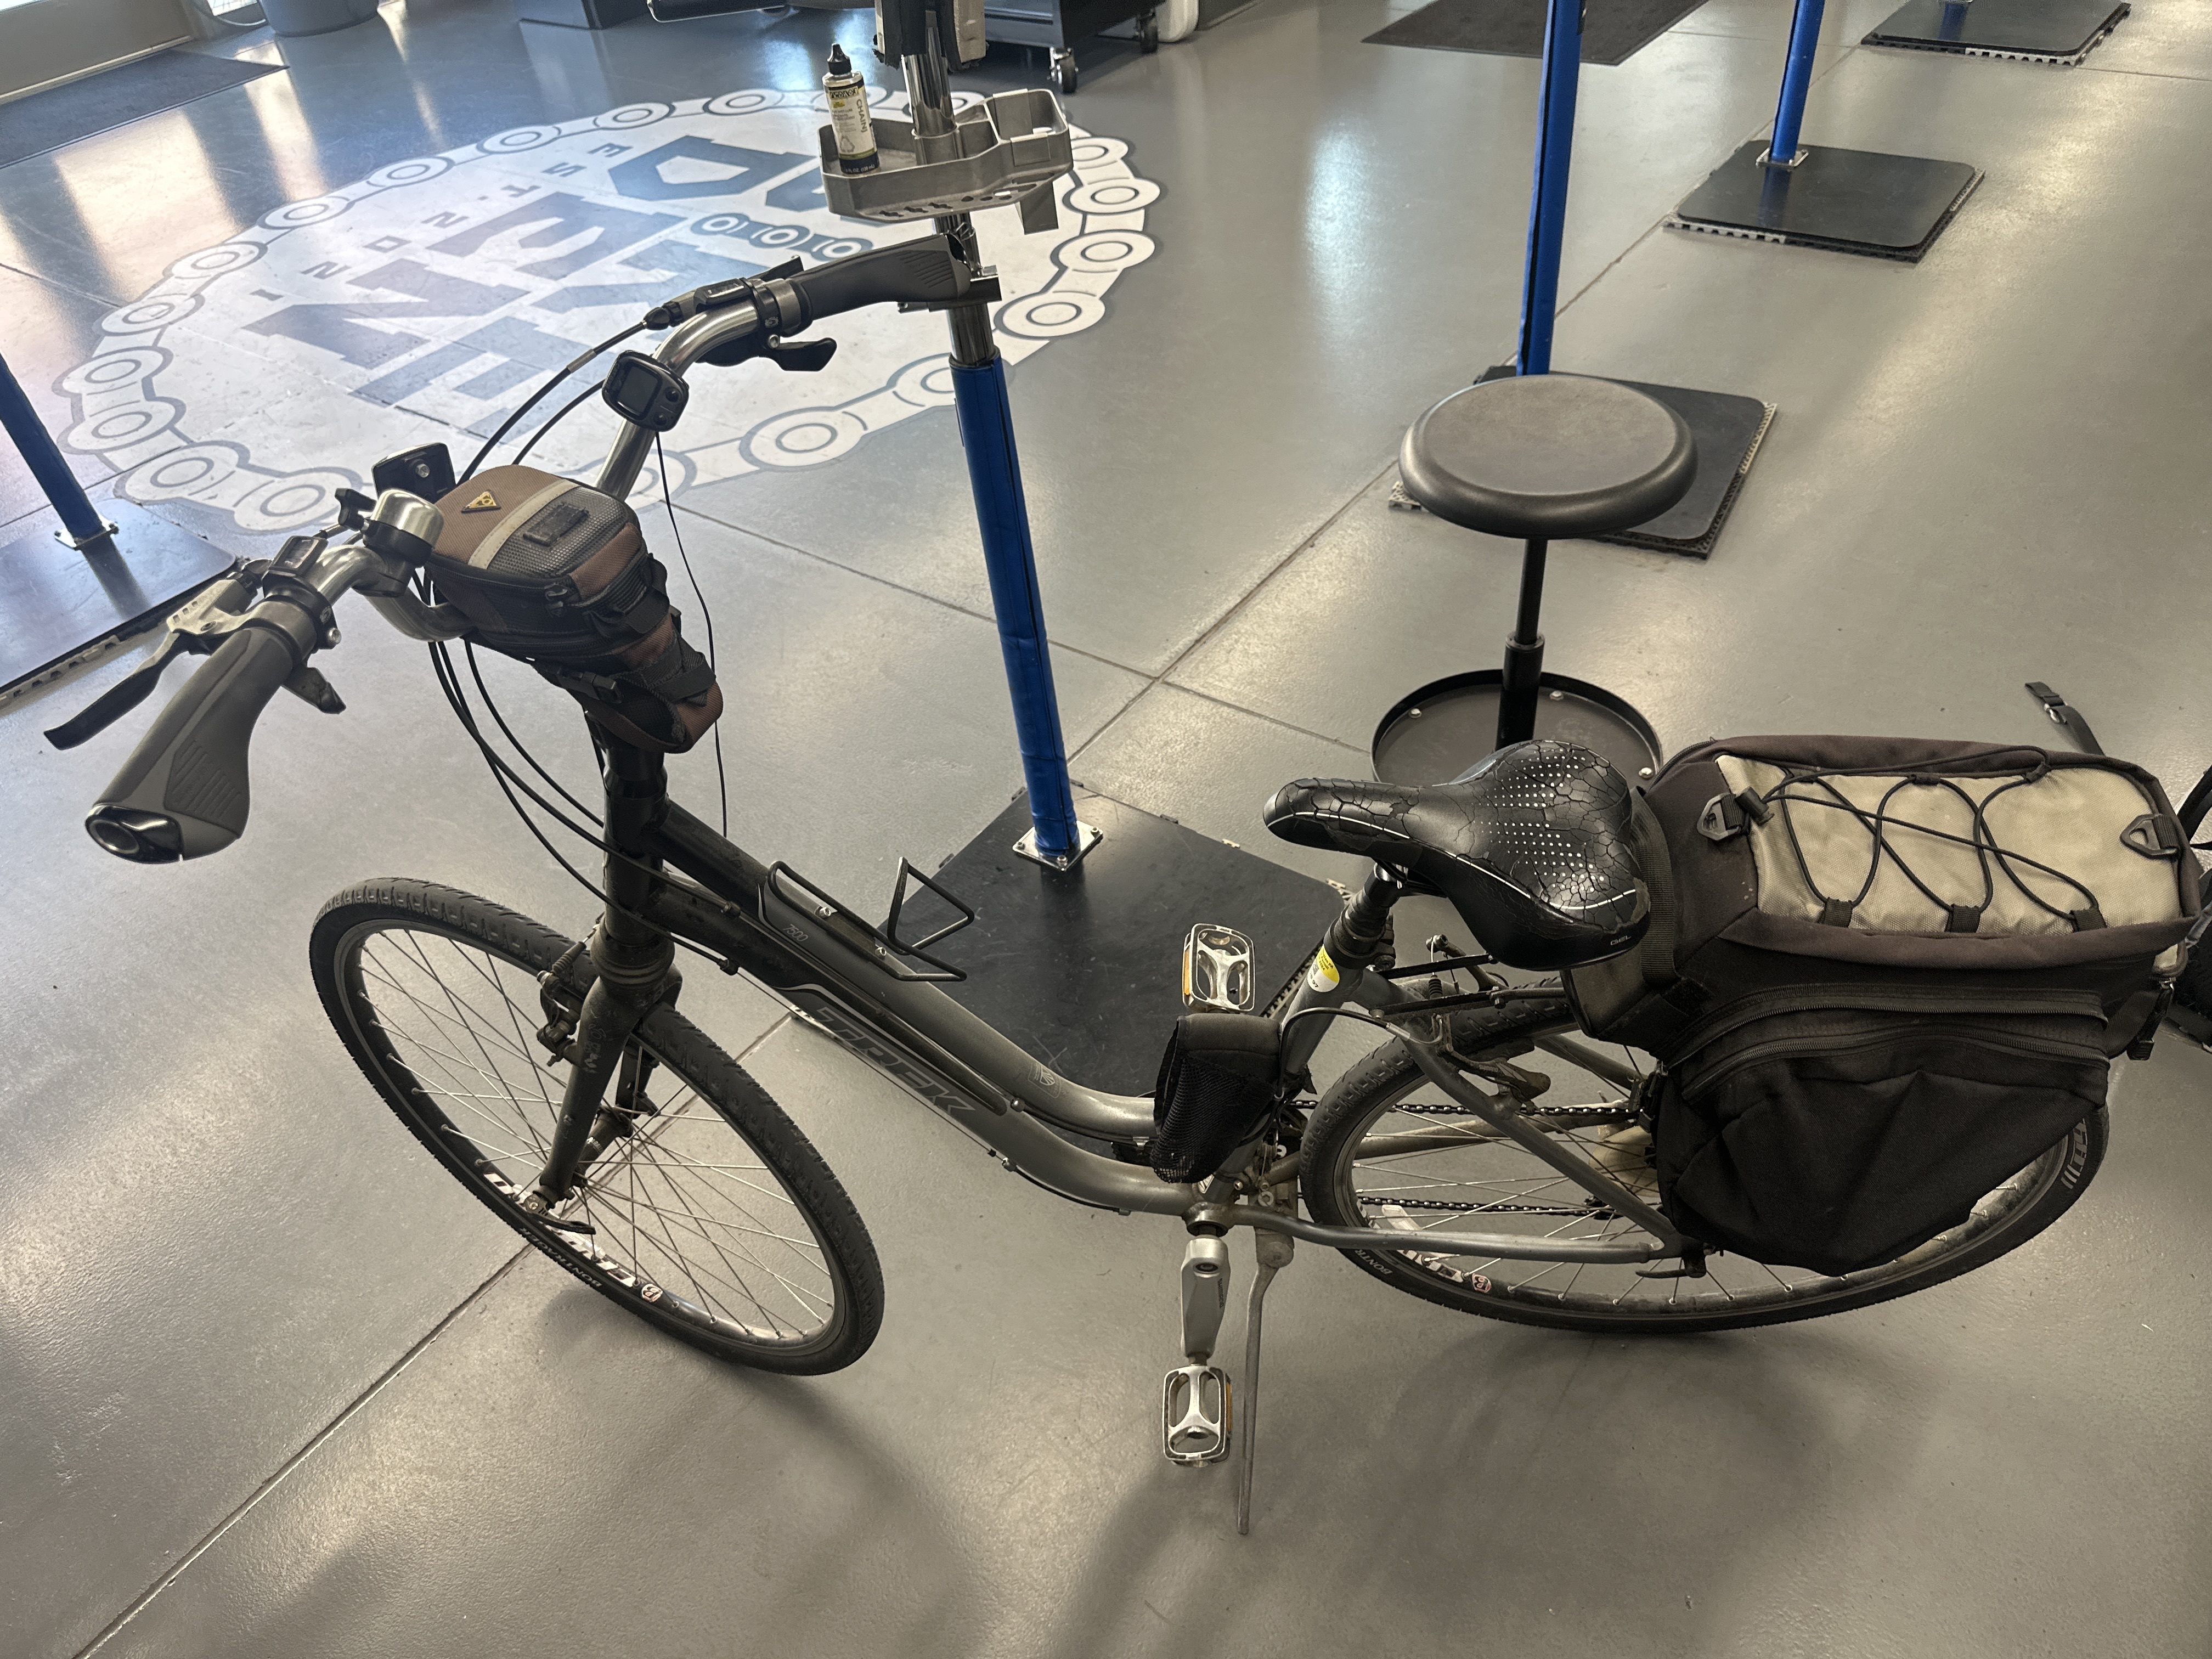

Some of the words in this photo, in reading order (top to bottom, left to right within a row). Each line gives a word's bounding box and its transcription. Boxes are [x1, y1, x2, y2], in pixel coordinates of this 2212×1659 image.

[783, 923, 809, 942] 7500
[1610, 935, 1632, 945] GEL
[816, 1006, 977, 1115] TREK
[520, 1227, 602, 1287] BONTRAGER
